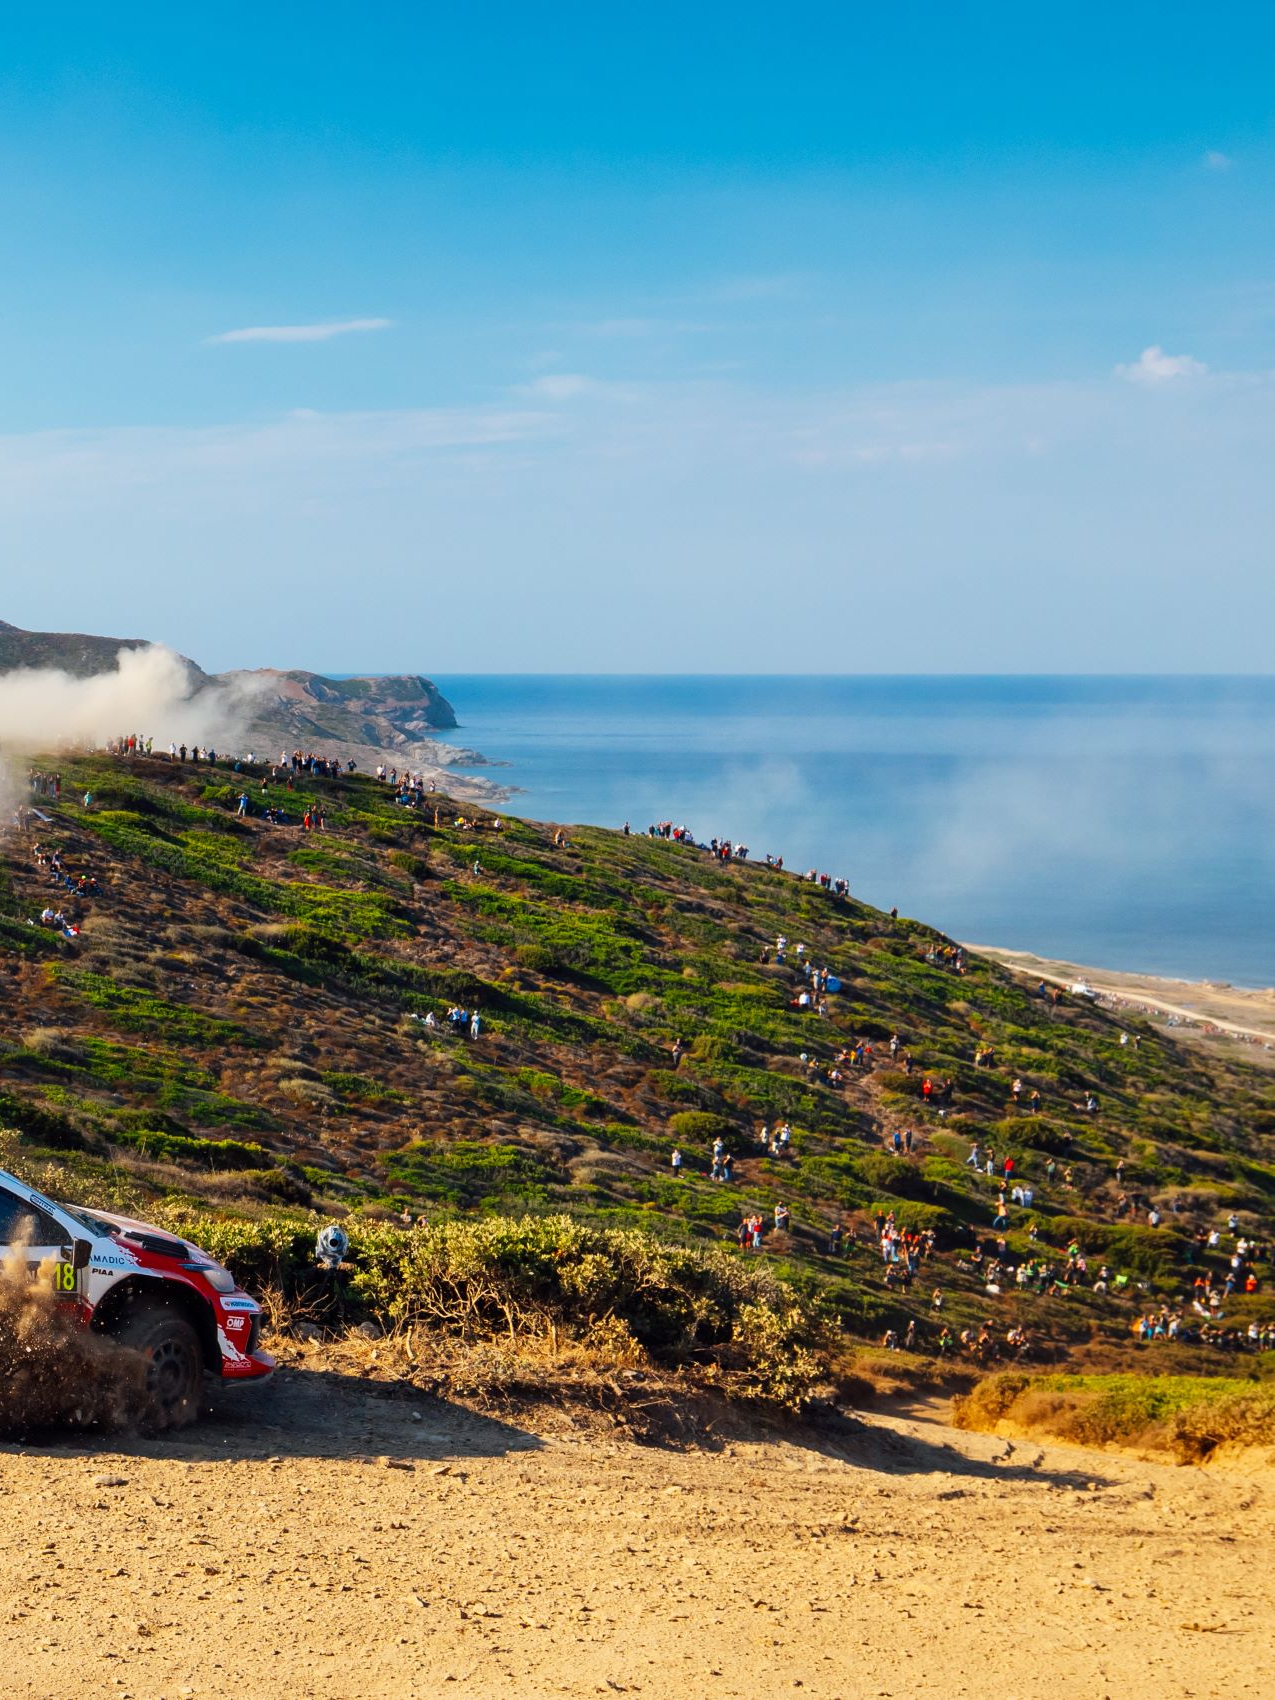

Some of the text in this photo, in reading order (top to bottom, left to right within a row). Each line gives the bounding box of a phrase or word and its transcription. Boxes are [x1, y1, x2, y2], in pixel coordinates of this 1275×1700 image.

[54, 1263, 74, 1291] 18
[92, 1268, 114, 1276] PIAA
[226, 1318, 245, 1328] OMP
